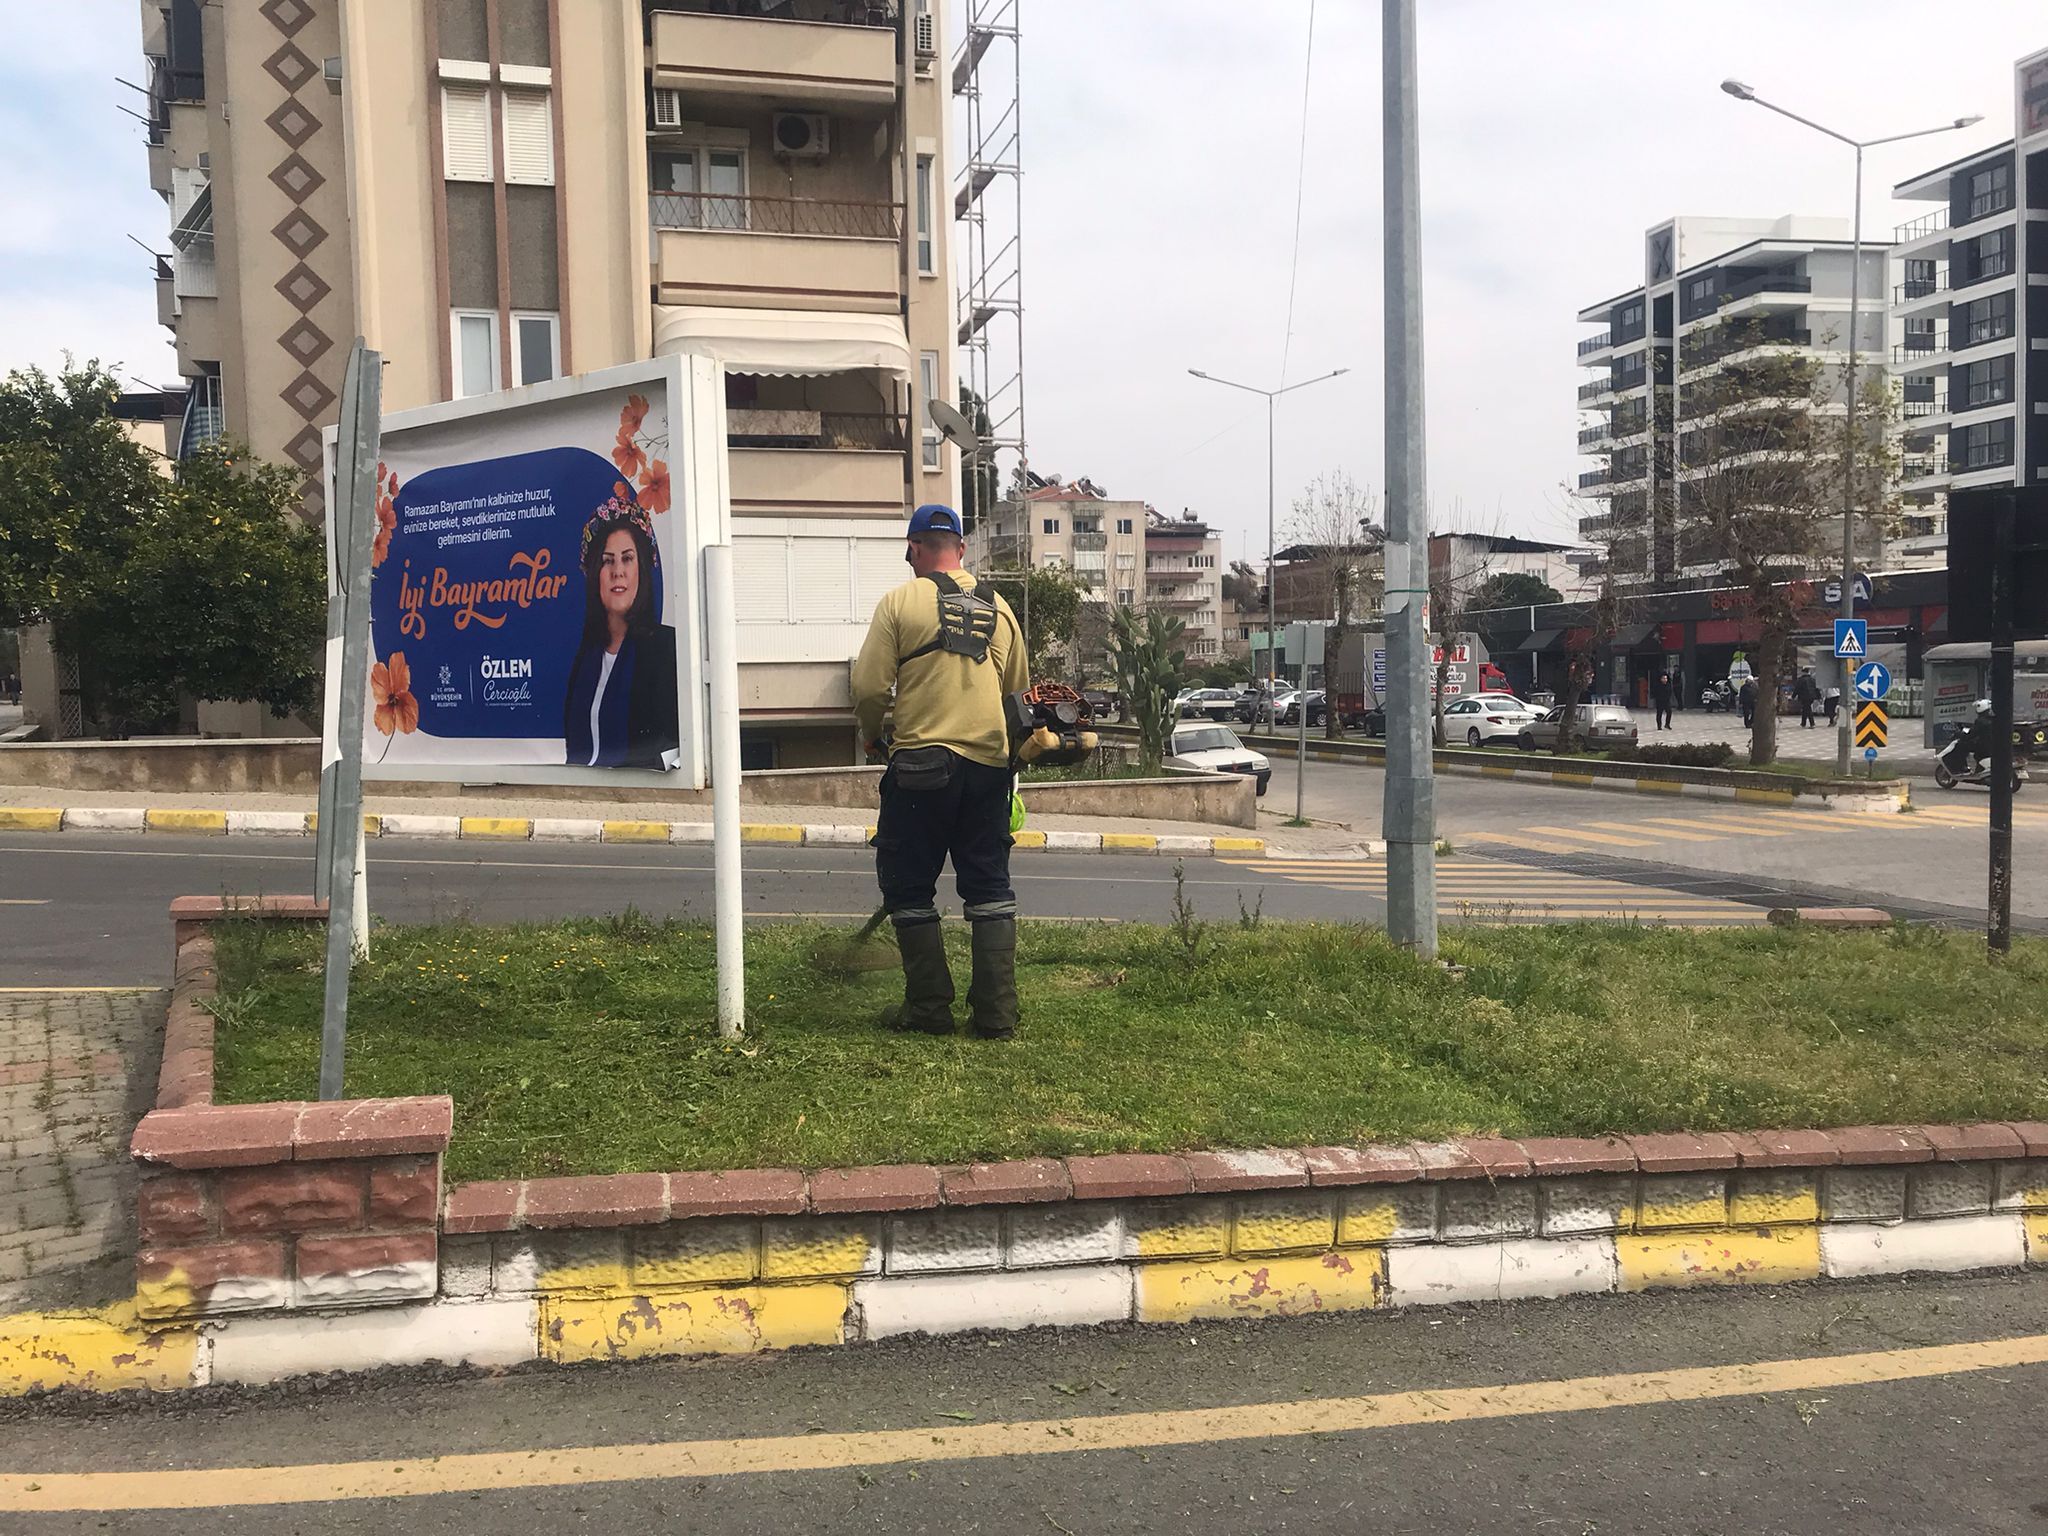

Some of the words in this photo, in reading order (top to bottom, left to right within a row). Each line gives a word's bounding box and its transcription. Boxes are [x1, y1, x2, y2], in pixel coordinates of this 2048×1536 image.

[404, 505, 439, 518] Ramazan
[440, 496, 487, 514] Bayramı'nın
[488, 491, 524, 506] kalbinize
[525, 488, 552, 501] huzur,
[403, 520, 428, 534] evinize
[428, 516, 460, 531] bereket,
[461, 509, 517, 527] sevdiklerinize
[517, 503, 556, 519] mutluluk
[437, 531, 481, 549] getirmesini
[482, 526, 513, 541] dilerim.
[400, 559, 427, 640] İyi
[430, 548, 567, 630] Bayramlar
[481, 655, 532, 679] ÖZLEM
